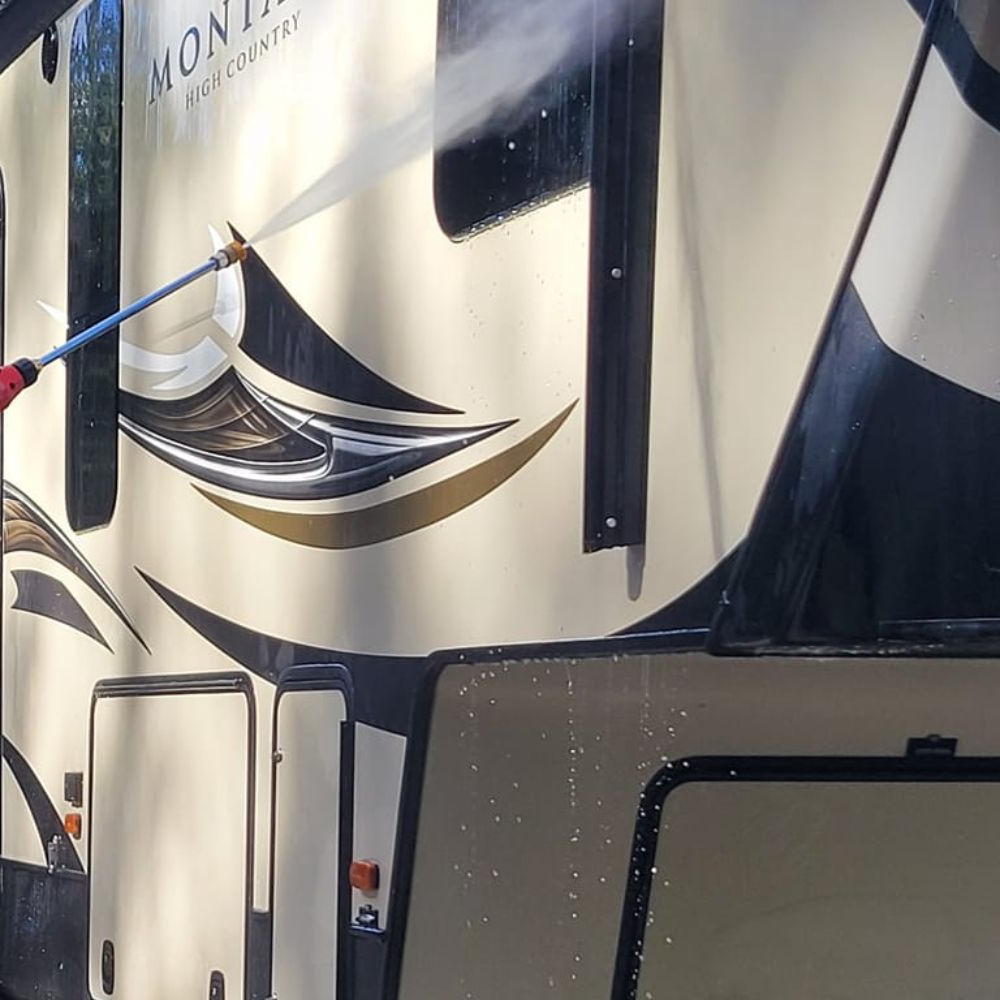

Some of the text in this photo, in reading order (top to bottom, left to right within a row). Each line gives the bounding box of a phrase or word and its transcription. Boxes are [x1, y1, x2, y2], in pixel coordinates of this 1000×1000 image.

[149, 0, 286, 105] MONT
[185, 9, 301, 111] HIGH COUNTRY
